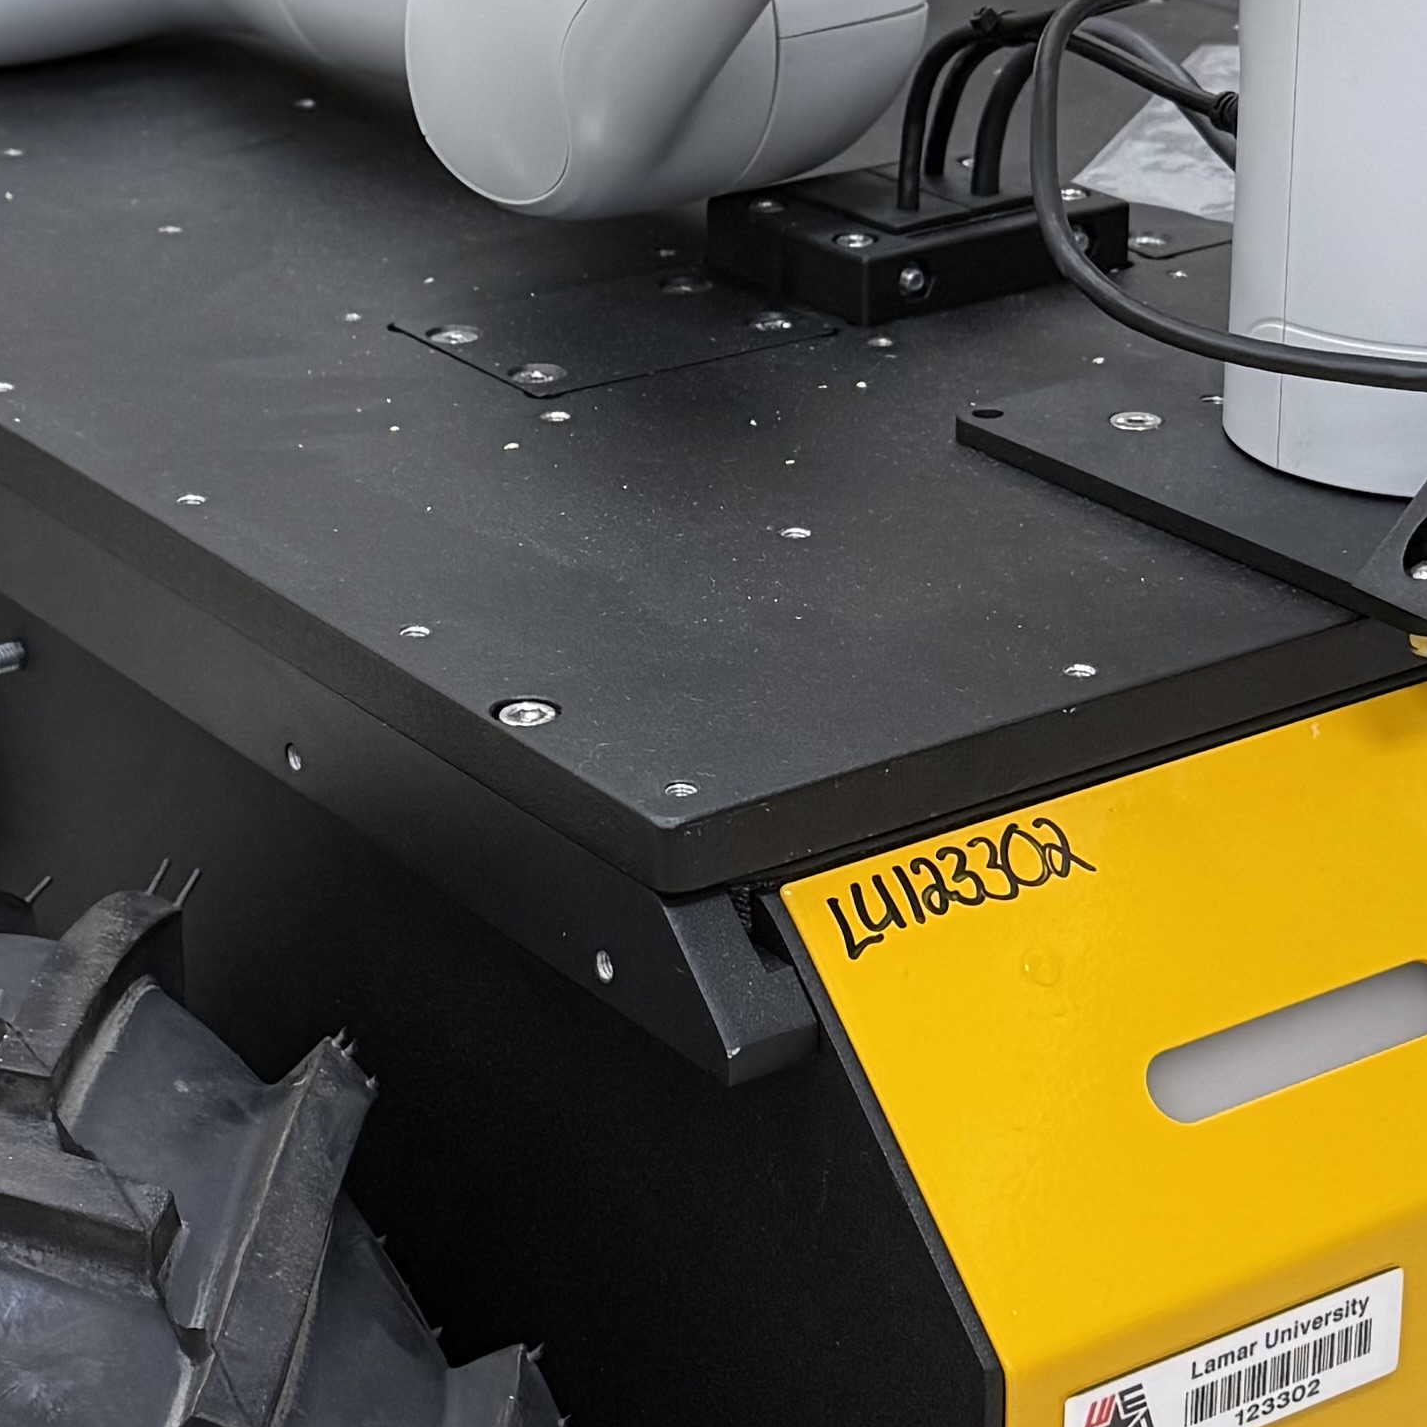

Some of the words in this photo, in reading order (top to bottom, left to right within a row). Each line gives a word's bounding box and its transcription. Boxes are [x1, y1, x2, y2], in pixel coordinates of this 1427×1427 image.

[1190, 1338, 1258, 1380] Lamar
[1264, 1296, 1371, 1350] University
[1234, 1378, 1321, 1427] 123302
